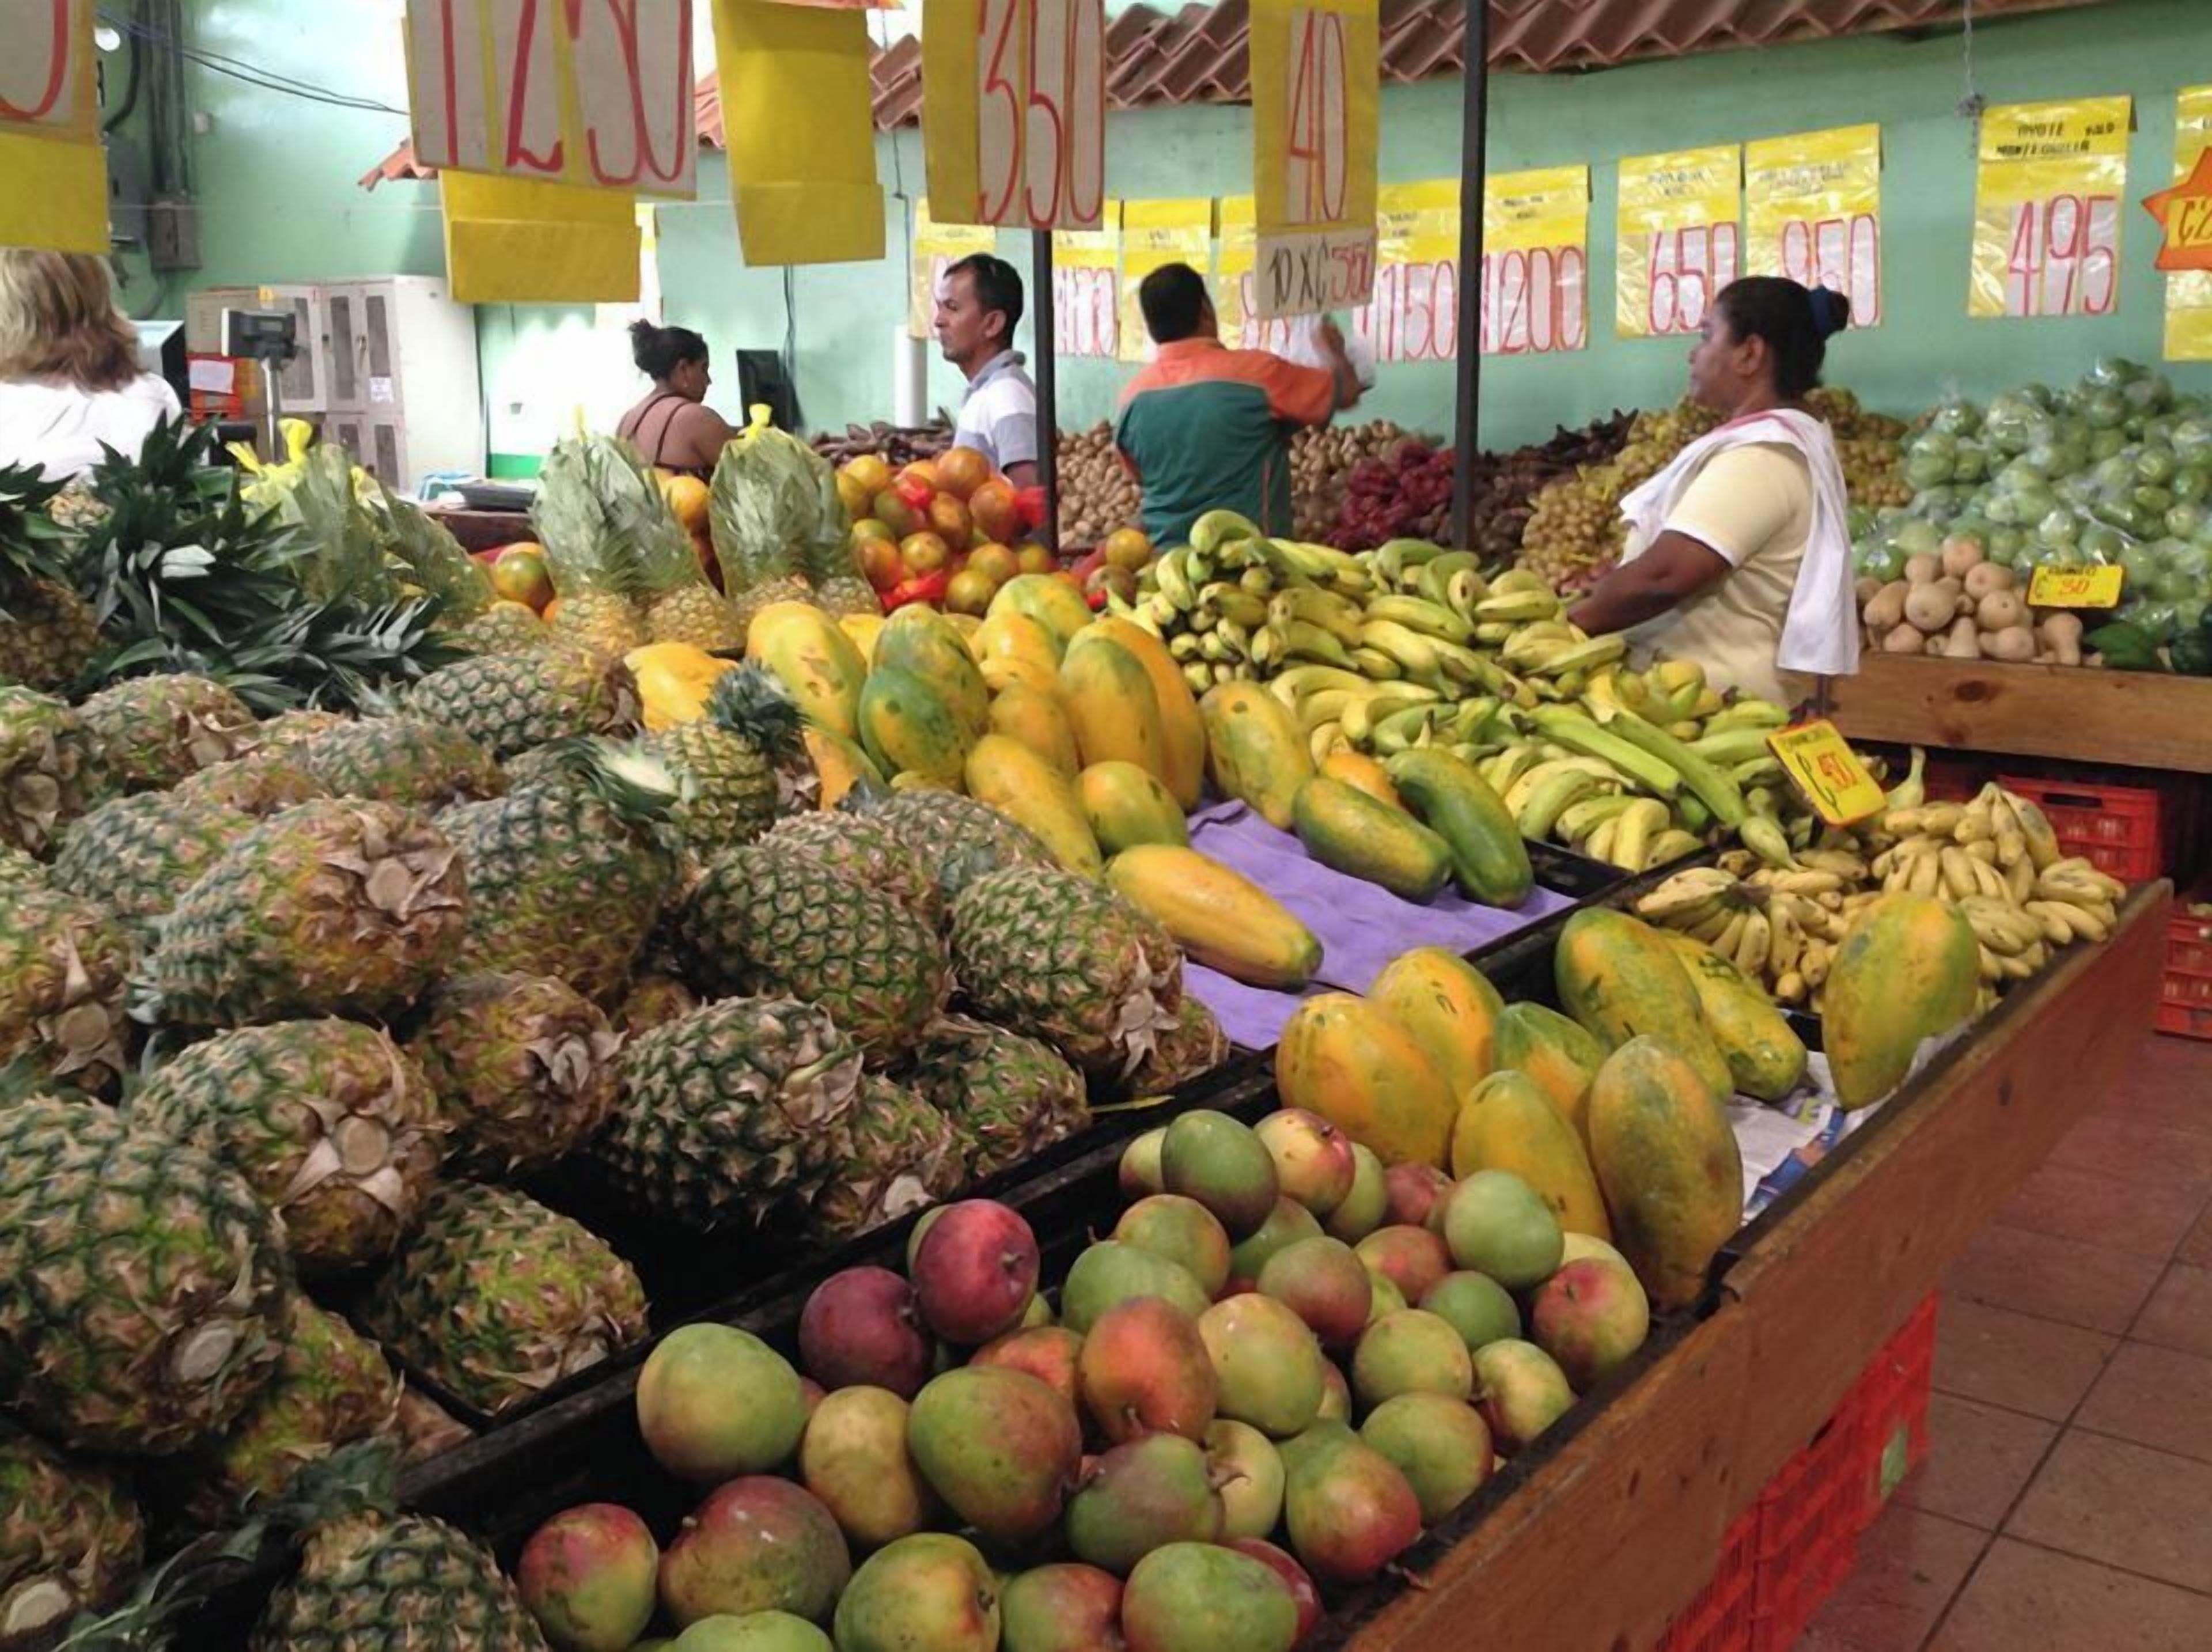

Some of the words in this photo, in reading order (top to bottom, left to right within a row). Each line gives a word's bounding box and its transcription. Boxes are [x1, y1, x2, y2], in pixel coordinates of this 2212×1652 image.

[977, 0, 1104, 229] 350
[1289, 10, 1347, 223] 40
[2008, 194, 2117, 317] 495
